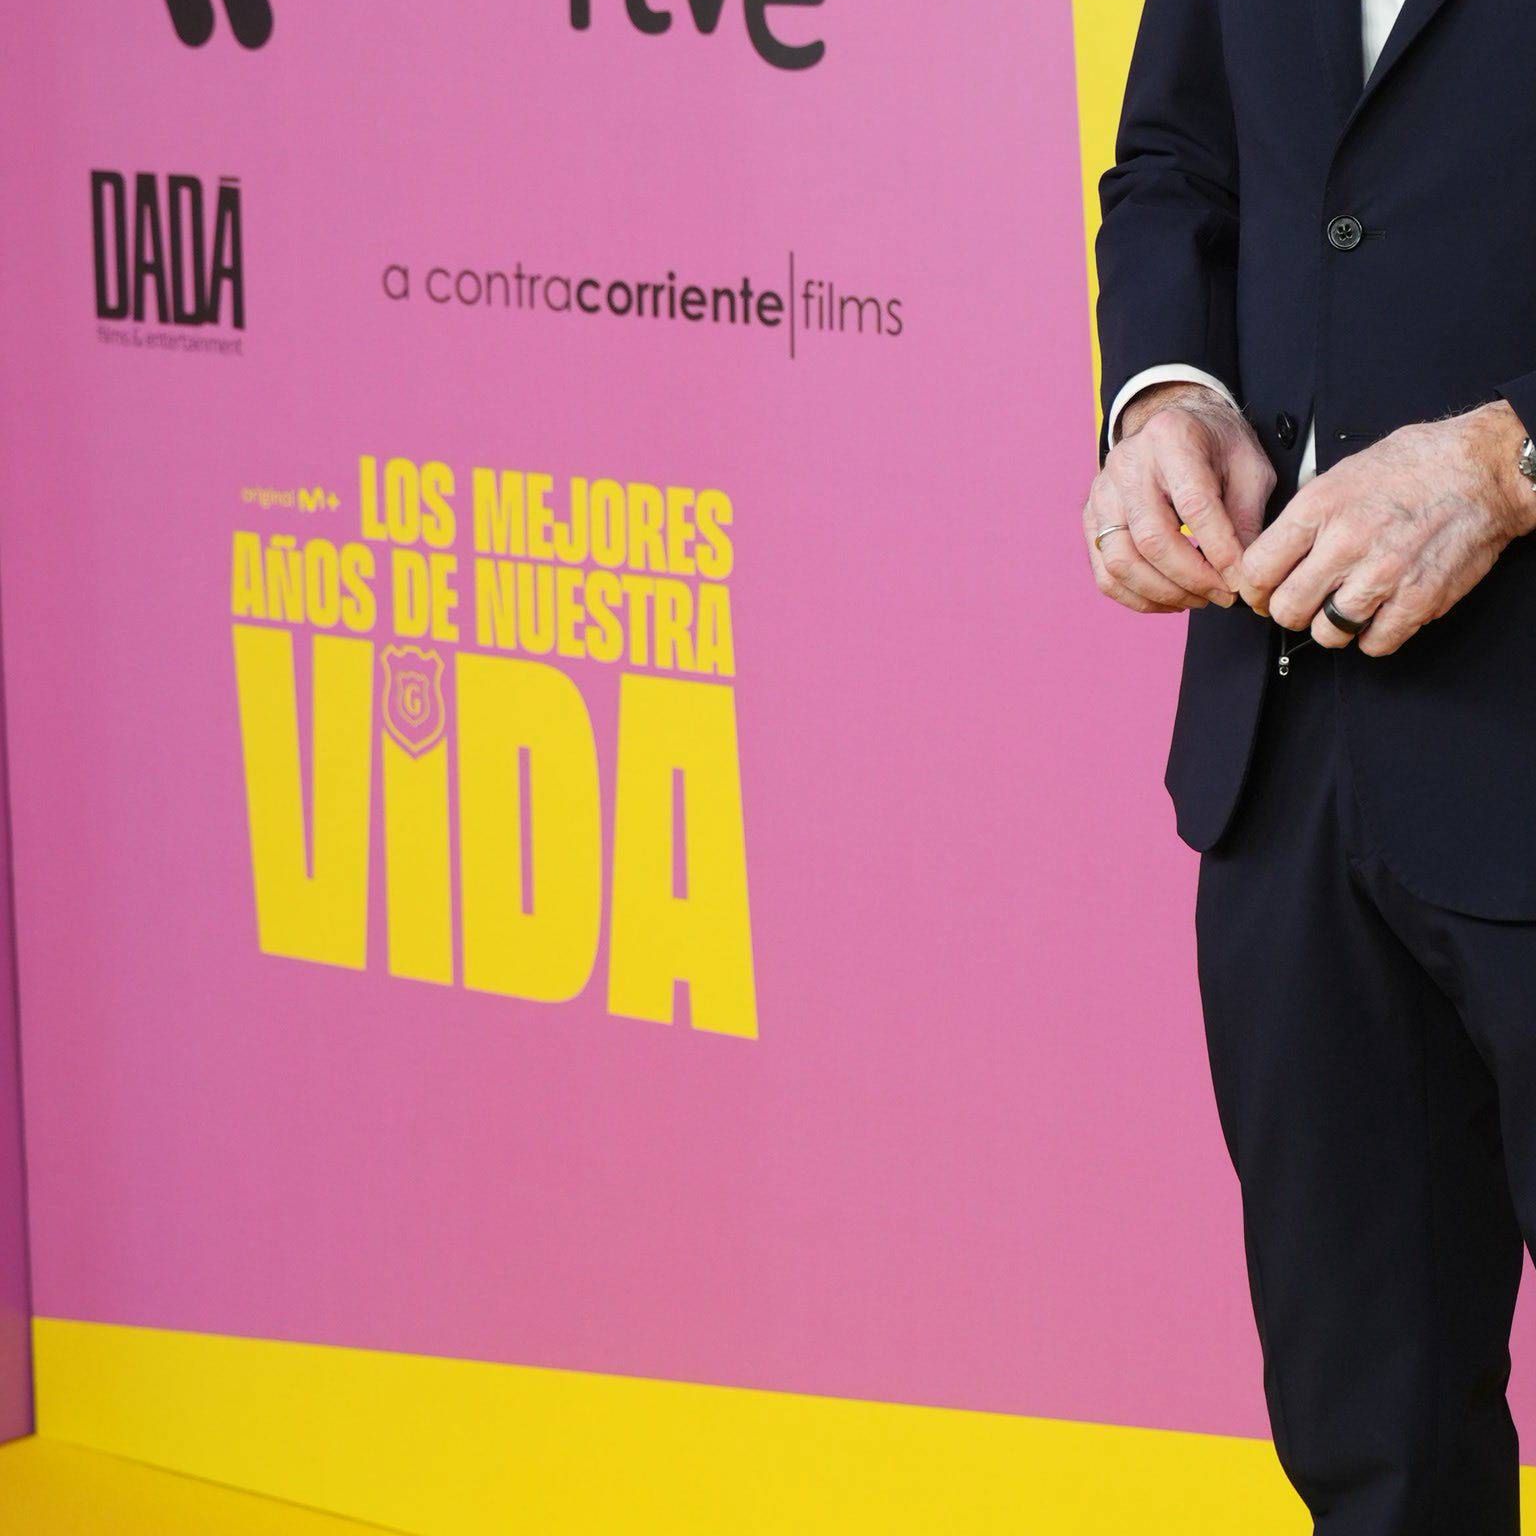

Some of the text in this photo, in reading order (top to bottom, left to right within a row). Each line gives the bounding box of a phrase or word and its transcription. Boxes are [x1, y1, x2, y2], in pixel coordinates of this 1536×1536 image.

[381, 263, 410, 301] a
[801, 279, 905, 338] films
[359, 454, 734, 581] LOS MEJORES
[231, 530, 736, 677] AÑOS DE NUESTRA
